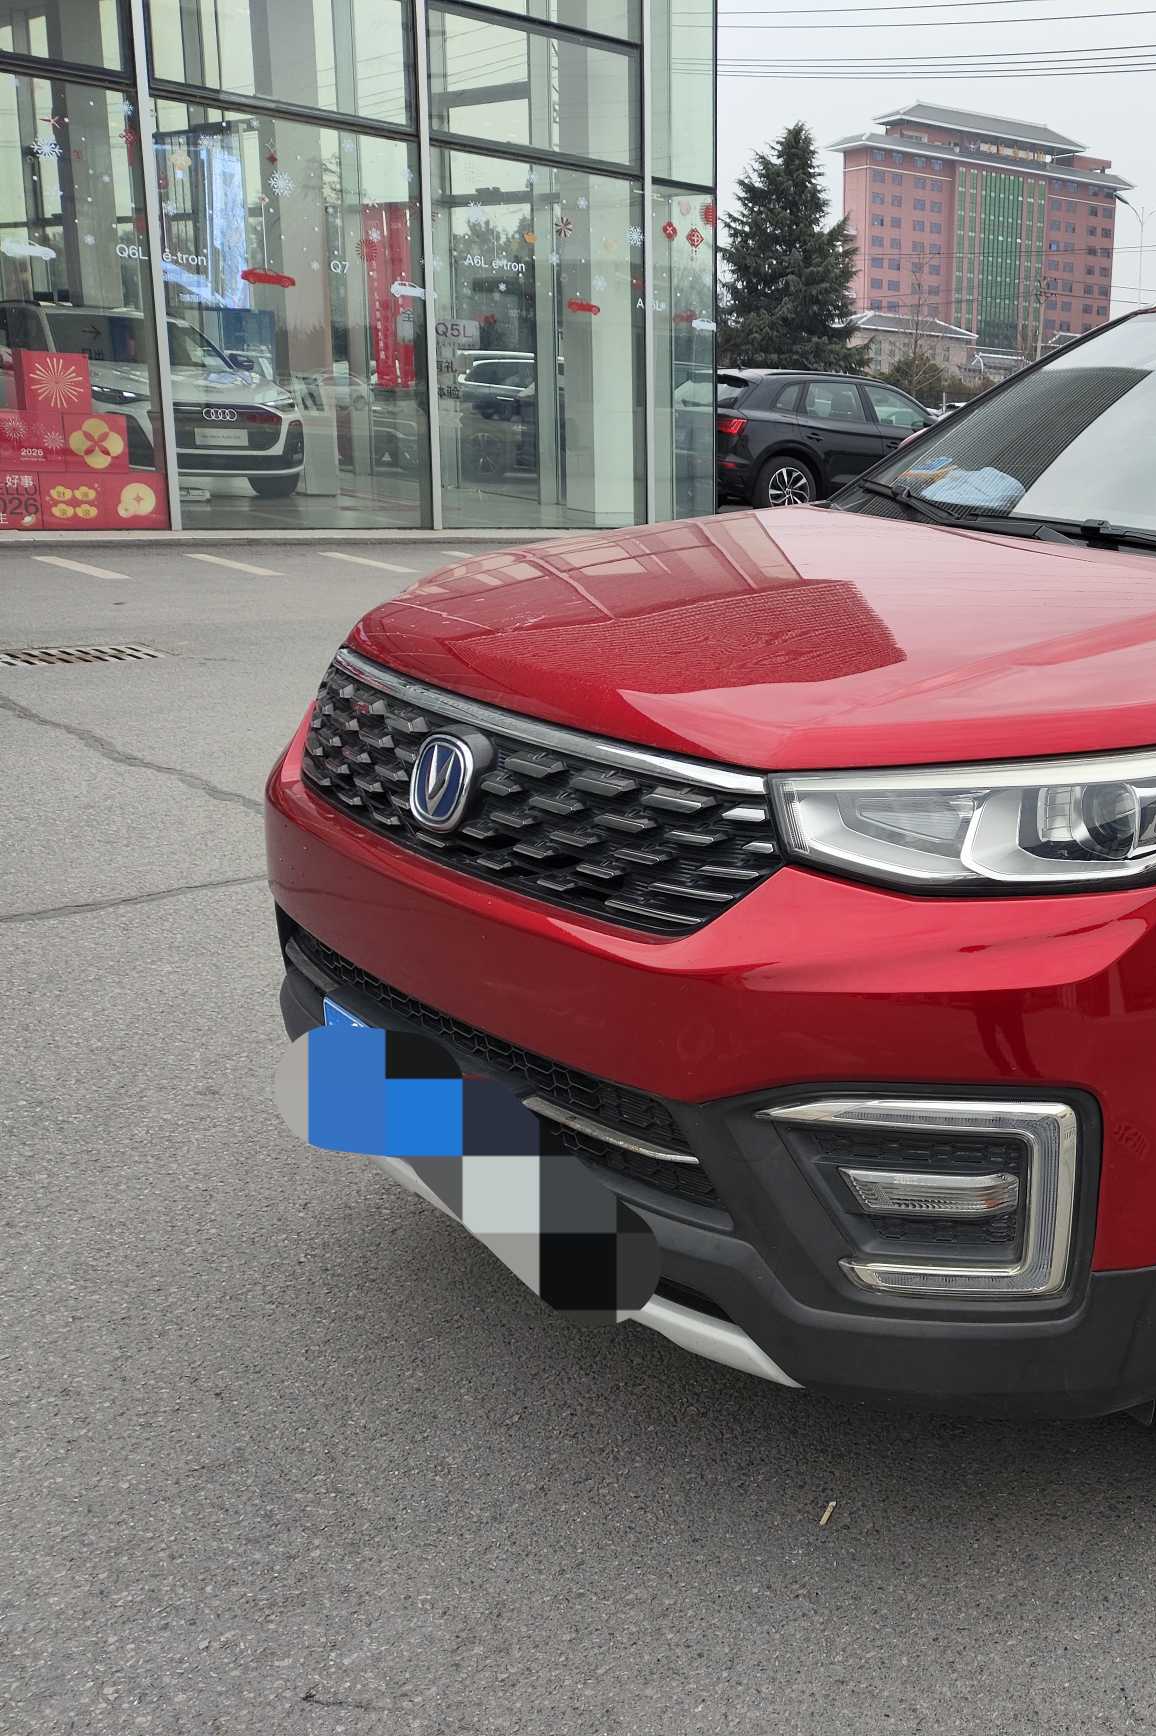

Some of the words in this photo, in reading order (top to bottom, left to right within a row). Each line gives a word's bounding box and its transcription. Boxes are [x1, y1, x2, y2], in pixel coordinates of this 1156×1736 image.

[116, 243, 149, 260] Q6L
[162, 252, 209, 266] e-tron
[331, 260, 350, 274] Q7
[464, 256, 489, 268] A6L
[492, 259, 526, 272] e-tron
[436, 322, 473, 338] Q5L
[21, 447, 44, 457] 2026
